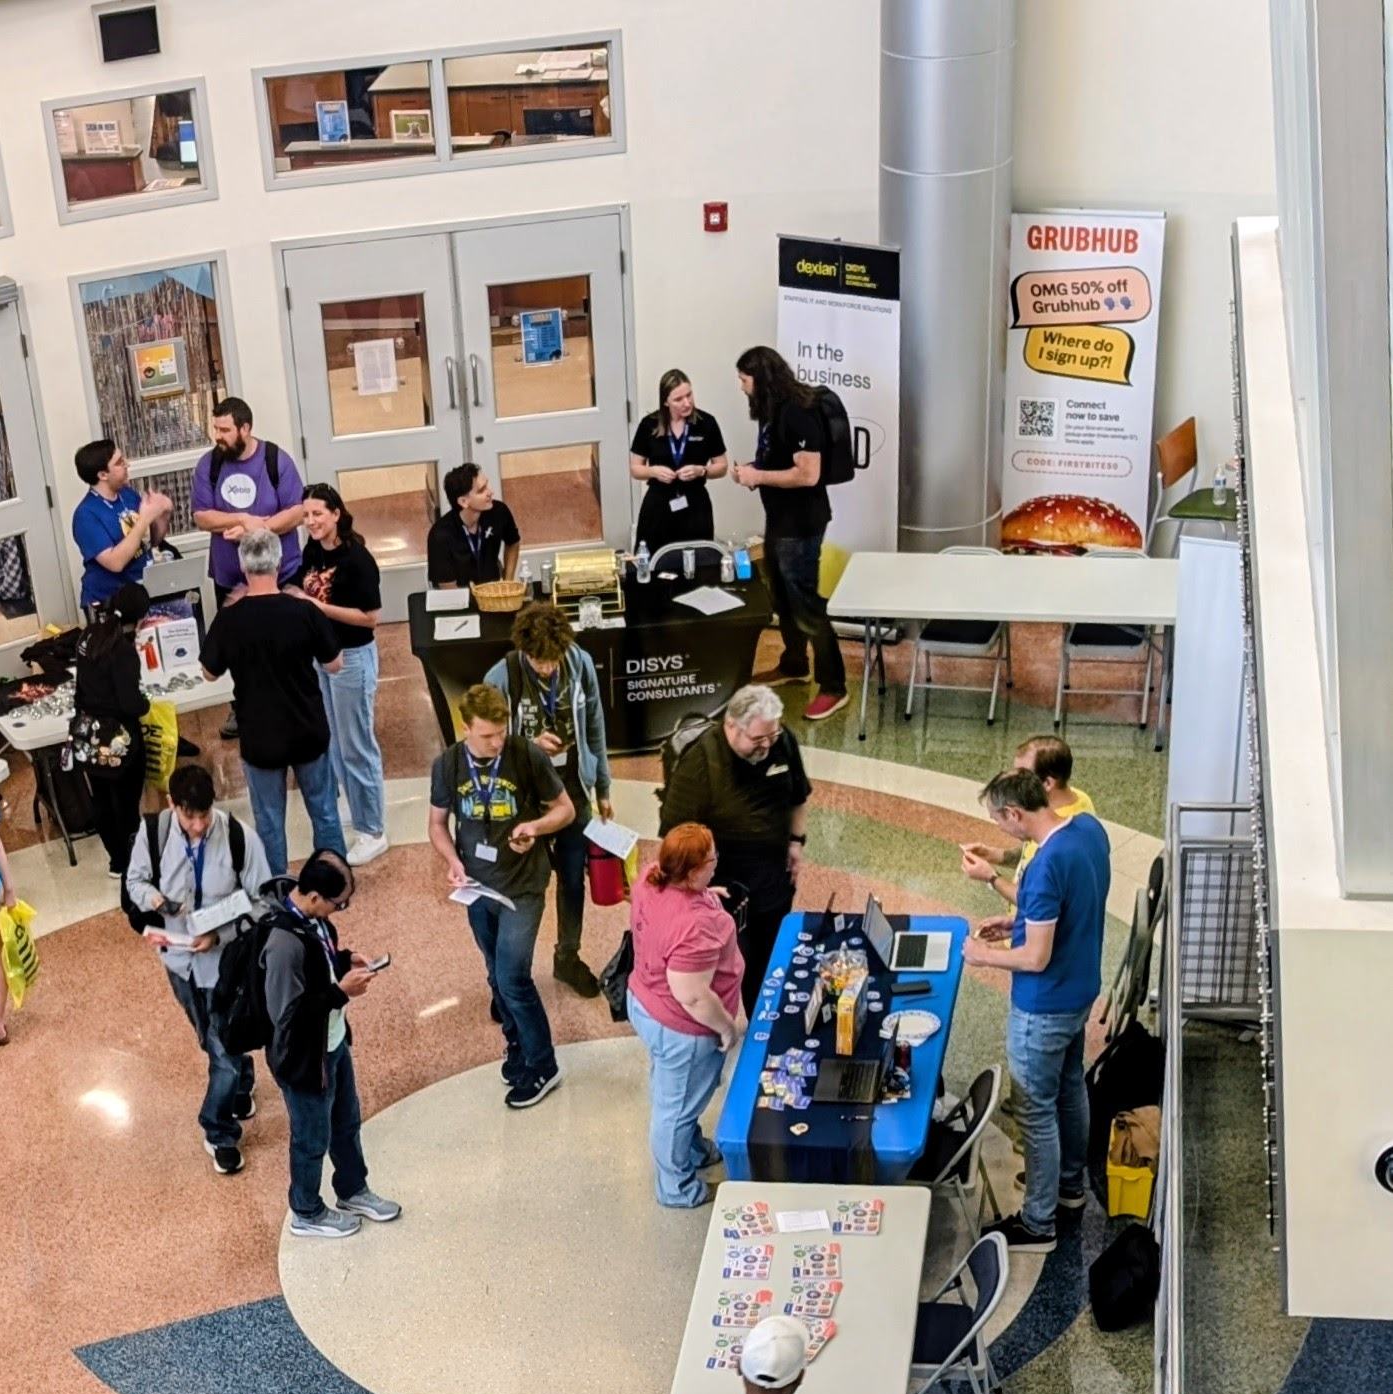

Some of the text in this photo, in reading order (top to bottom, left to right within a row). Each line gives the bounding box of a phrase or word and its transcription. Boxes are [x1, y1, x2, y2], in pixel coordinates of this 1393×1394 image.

[1027, 225, 1139, 254] GRUBHUB
[796, 259, 836, 276] dexian
[1030, 279, 1128, 297] OMG 50% off
[1032, 298, 1101, 314] Grubhub
[1043, 330, 1114, 353] Where do
[797, 340, 844, 362] In the
[1038, 347, 1113, 370] I sign up?!
[797, 364, 871, 390] business
[1066, 399, 1107, 410] Connect
[1065, 412, 1120, 423] now to save
[1027, 457, 1055, 466] CODE:
[626, 654, 684, 674] DISYS
[627, 673, 697, 690] SIGNATURE
[627, 683, 716, 702] CONSULTANTS
